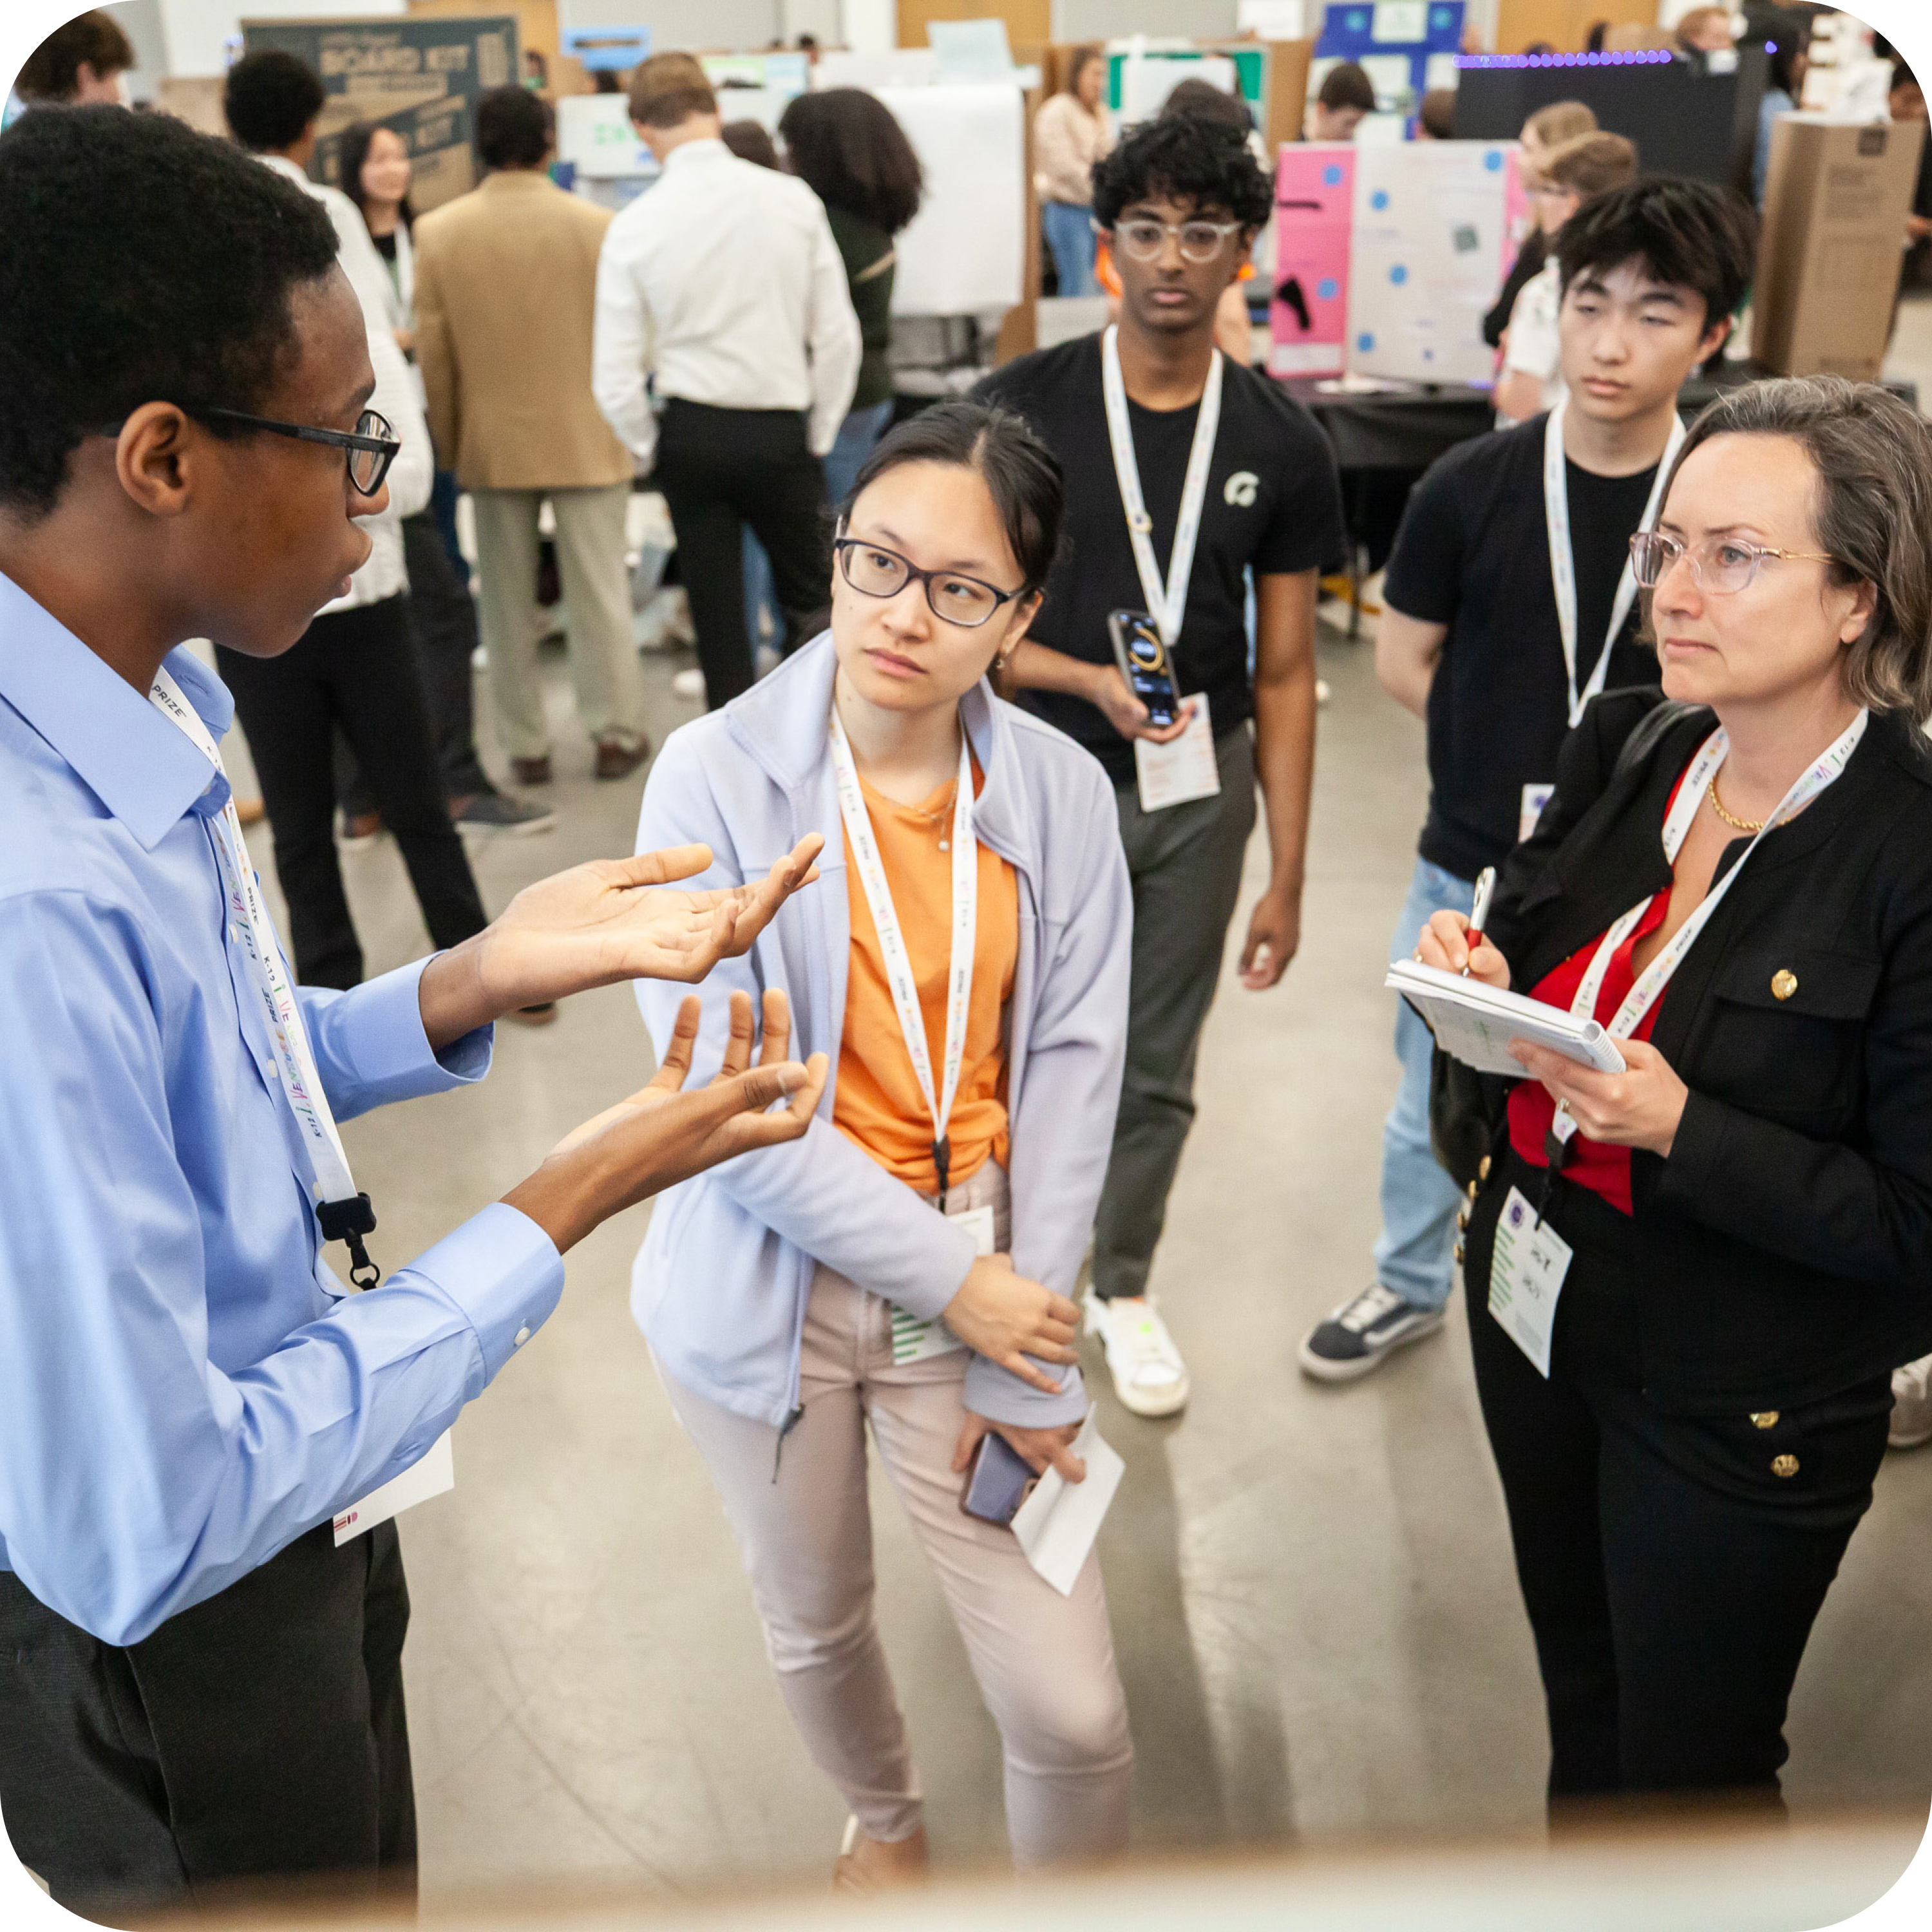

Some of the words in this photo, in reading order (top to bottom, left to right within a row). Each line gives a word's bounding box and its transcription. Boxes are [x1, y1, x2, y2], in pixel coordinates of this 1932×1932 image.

[152, 684, 187, 717] PRIZE
[1691, 760, 1709, 788] PRIZE
[247, 886, 259, 924] PRIZE
[1675, 927, 1692, 952] PRIZE
[264, 956, 276, 982] K-12
[261, 987, 278, 1023] PRIZE
